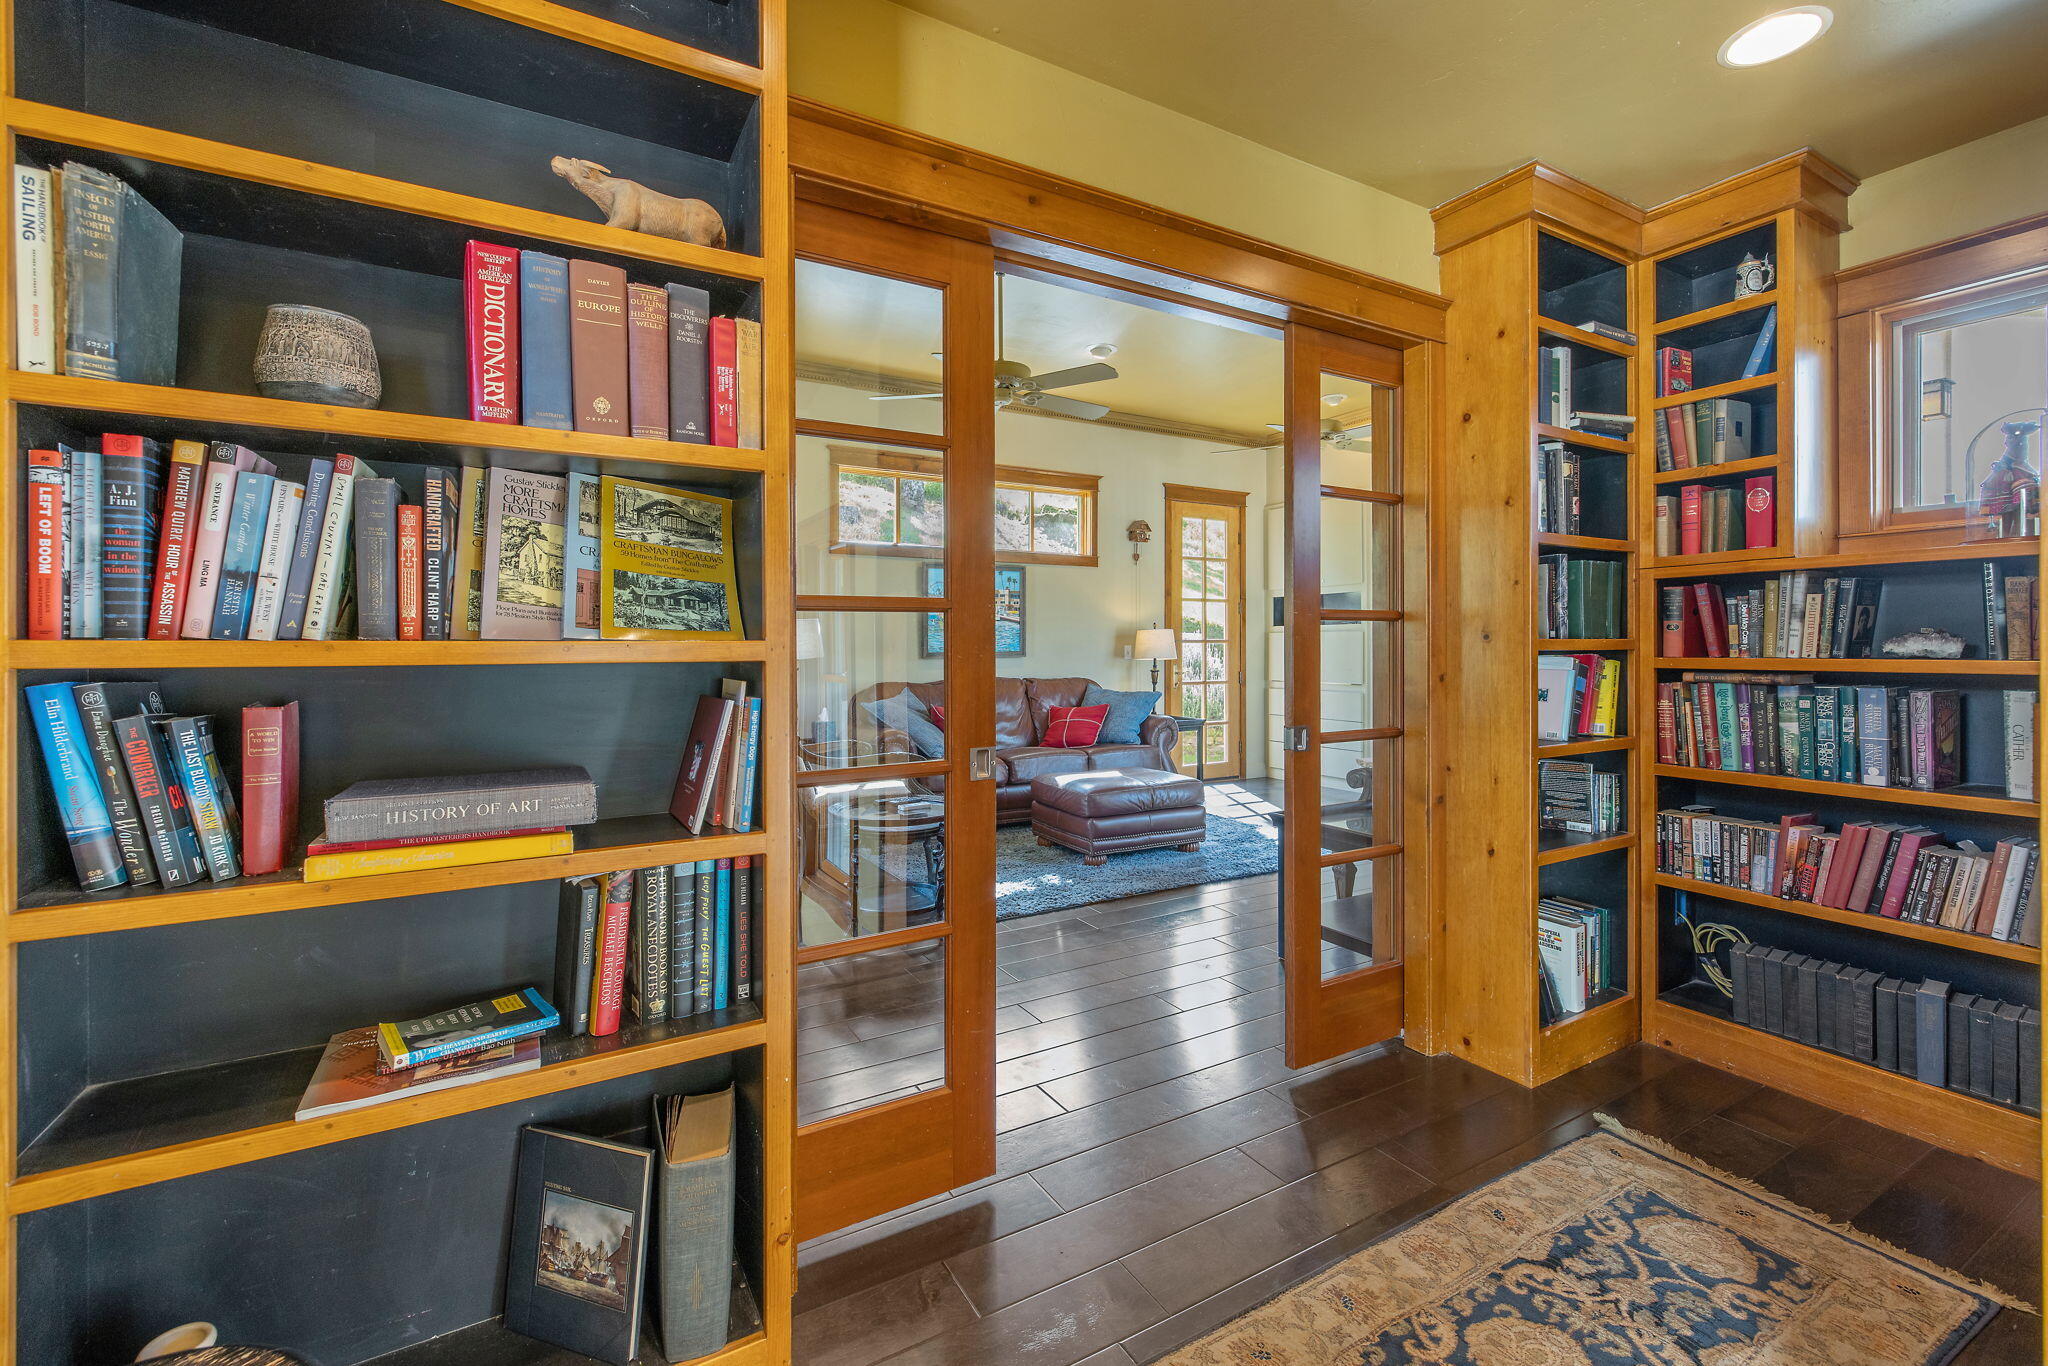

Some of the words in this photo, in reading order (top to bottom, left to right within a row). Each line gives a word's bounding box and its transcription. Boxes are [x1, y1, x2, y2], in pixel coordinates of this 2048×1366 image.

[21, 175, 37, 241] SAILING
[73, 188, 116, 209] INSECTS
[37, 188, 49, 234] HANDBOOK
[73, 206, 116, 225] WESTERN
[74, 225, 116, 242] AMERICA
[79, 216, 112, 234] NORTH
[477, 268, 513, 280] AMERICAN
[478, 273, 513, 286] HERITAGE
[487, 264, 503, 273] THE
[587, 277, 611, 287] DAVIES
[576, 299, 622, 314] EUROPE
[630, 297, 668, 312] OUTLINE
[640, 293, 660, 302] THE
[643, 305, 655, 313] OF
[630, 310, 668, 324] HISTORY
[682, 307, 697, 317] THE
[636, 320, 664, 331] WELLS
[677, 329, 697, 339] DANIEL
[483, 283, 506, 407] DICTIONARY
[477, 405, 513, 416] HOUGHTON
[585, 416, 620, 424] OXFORD
[109, 484, 123, 495] A.
[125, 484, 137, 495] J.
[175, 466, 193, 509] MATTHEW
[305, 472, 325, 507] Drawing
[331, 476, 347, 507] SMALL
[503, 483, 541, 499] MORE
[504, 474, 535, 487] Gustav
[38, 486, 52, 516] LEFT
[109, 495, 138, 507] Finn
[209, 482, 223, 524] SEVERANCE
[276, 484, 288, 513] UPSTAIRS
[426, 479, 442, 551] HANDCRAFTED
[502, 503, 547, 520] HOMES
[38, 519, 52, 535] OF
[170, 511, 186, 541] QUIRK
[235, 522, 251, 553] Garden
[271, 522, 282, 543] WHITE
[298, 509, 318, 559] Conclusions
[322, 511, 339, 558] COUNTRY
[104, 538, 142, 547] woman
[613, 540, 669, 560] CRAFTSMAN
[670, 550, 725, 565] BUNGALOWS
[37, 537, 52, 575] BOOM
[107, 551, 119, 561] in
[121, 551, 138, 561] the
[165, 544, 180, 569] HOUR
[267, 543, 279, 567] HOUSE
[629, 551, 654, 561] Homes
[103, 565, 142, 575] window
[202, 560, 212, 576] LING
[427, 557, 440, 589] CLINT
[199, 575, 209, 589] MA
[1983, 562, 1994, 607] FLYBOYS
[158, 581, 176, 625] ASSASSIN
[222, 579, 237, 616] HANNAH
[230, 580, 244, 616] KRISTIN
[427, 592, 440, 621] HARP
[262, 603, 272, 623] WEST
[1751, 599, 1759, 623] BROWN
[1805, 631, 1815, 654] WOMEN
[43, 697, 62, 723] Elin
[1825, 695, 1835, 716] MAEVE
[749, 709, 759, 746] High-Energy
[1864, 703, 1874, 734] SUMMER
[1873, 706, 1883, 732] FIREFLY
[128, 727, 137, 740] THE
[179, 729, 196, 745] THE
[2012, 724, 2026, 761] CATHER
[50, 722, 74, 783] Hilderbrand
[183, 745, 199, 768] LAST
[747, 745, 757, 762] Dogs
[1801, 736, 1810, 767] QUENTINS
[127, 738, 160, 799] COWORKER
[188, 767, 212, 800] BLOODY
[112, 797, 126, 818] The
[197, 800, 220, 832] STRAW
[386, 804, 471, 825] HISTORY
[476, 801, 502, 817] OF
[507, 798, 544, 814] ART
[113, 815, 142, 867] Wonder
[149, 804, 162, 831] FREIDA
[156, 829, 173, 864] McFADDEN
[207, 834, 221, 847] JD
[399, 837, 416, 846] THE
[211, 846, 229, 869] KIRK
[658, 875, 668, 898] THE
[700, 875, 711, 894] LUCY
[646, 875, 659, 918] ROYAL
[699, 896, 711, 920] FOLEY
[658, 900, 668, 945] OXFORD
[739, 911, 747, 932] LIES
[581, 926, 595, 966] TREASURES
[604, 914, 618, 955] MICHAEL
[614, 906, 630, 968] PRESIDENTIAL
[701, 928, 709, 942] THE
[739, 932, 747, 953] SHE
[646, 917, 659, 999] ANECDOTES
[658, 947, 668, 977] BOOK
[699, 943, 711, 977] GUEST
[739, 953, 748, 978] TOLD
[600, 956, 615, 1007] BESCHLOSS
[611, 968, 624, 1012] COURAGE
[658, 979, 668, 996] OF
[698, 978, 711, 998] LIST
[457, 1048, 477, 1058] WAR
[480, 1042, 496, 1052] Bao
[496, 1036, 517, 1048] Ninh
